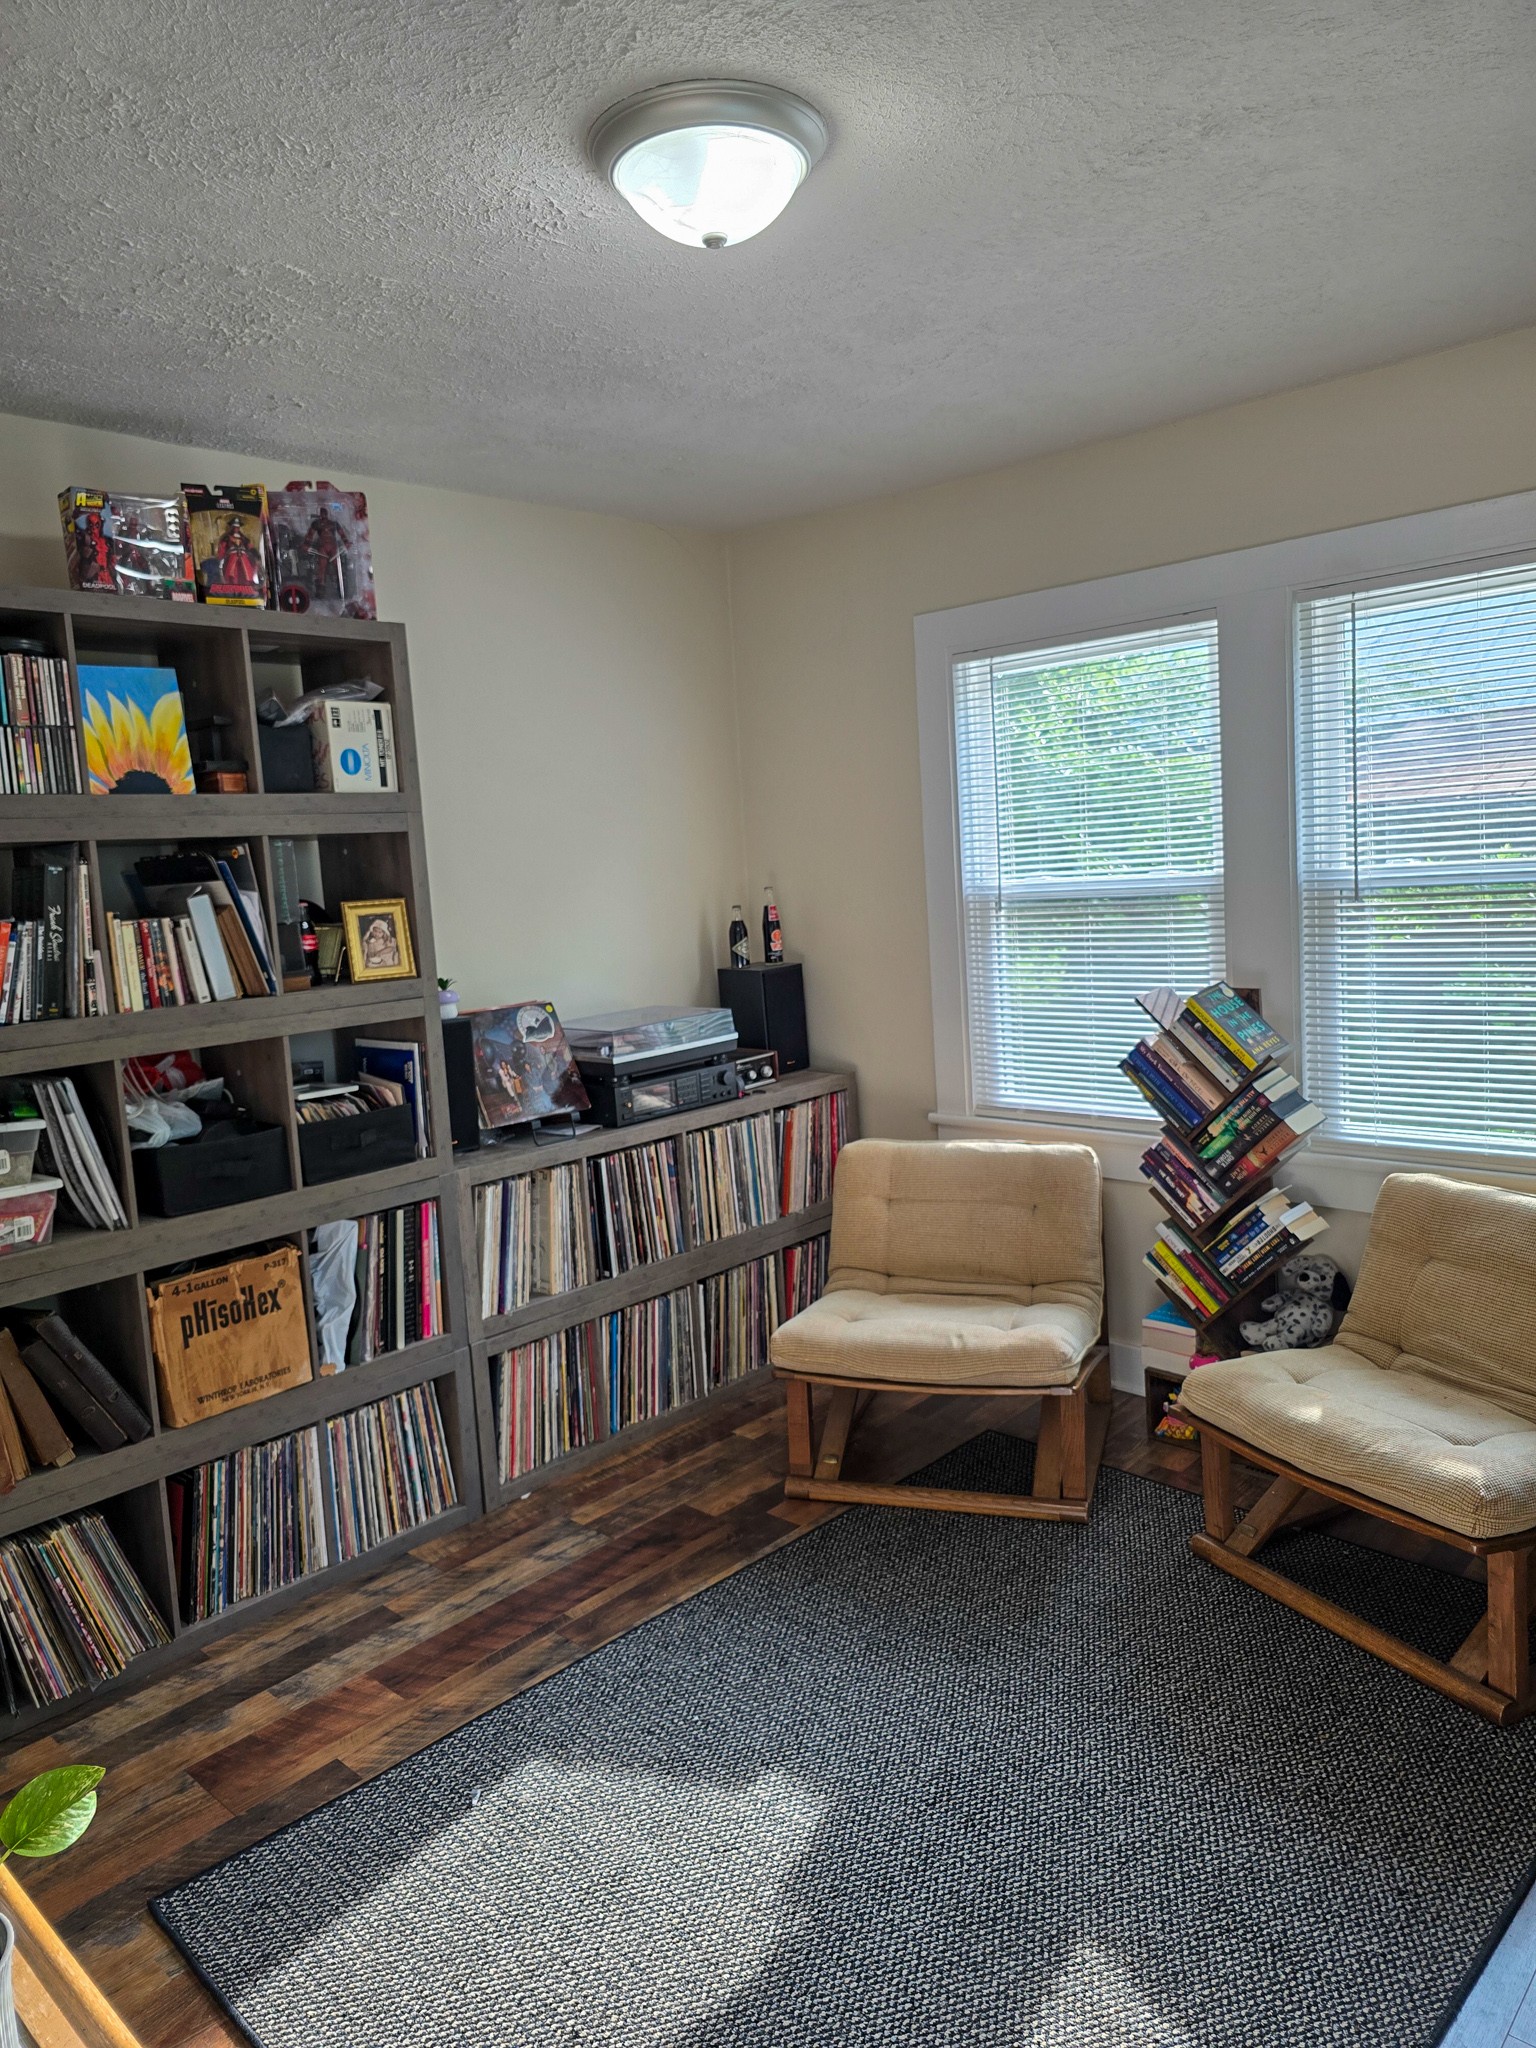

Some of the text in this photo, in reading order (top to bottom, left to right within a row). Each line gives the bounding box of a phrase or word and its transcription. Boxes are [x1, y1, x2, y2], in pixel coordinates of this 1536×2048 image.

[82, 582, 117, 590] DEADPOOL
[362, 743, 373, 782] MINOLTA
[47, 905, 63, 932] Frank
[1209, 996, 1246, 1019] HOUSE
[1228, 1011, 1253, 1029] IN THE
[1237, 1019, 1267, 1042] PINES
[1251, 1036, 1281, 1056] ANA REYES
[1144, 1051, 1158, 1065] Dark
[1245, 1089, 1256, 1099] ALL
[1249, 1113, 1268, 1130] YARROS
[1253, 1116, 1275, 1136] REBECCA
[1214, 1148, 1231, 1165] STORM
[1220, 1153, 1235, 1168] ONYX
[1228, 1162, 1246, 1179] FLAME
[1235, 1168, 1248, 1181] IRON
[172, 1275, 229, 1297] 4-1 GALLON
[197, 1366, 291, 1404] WINTHROP LABORATORIES
